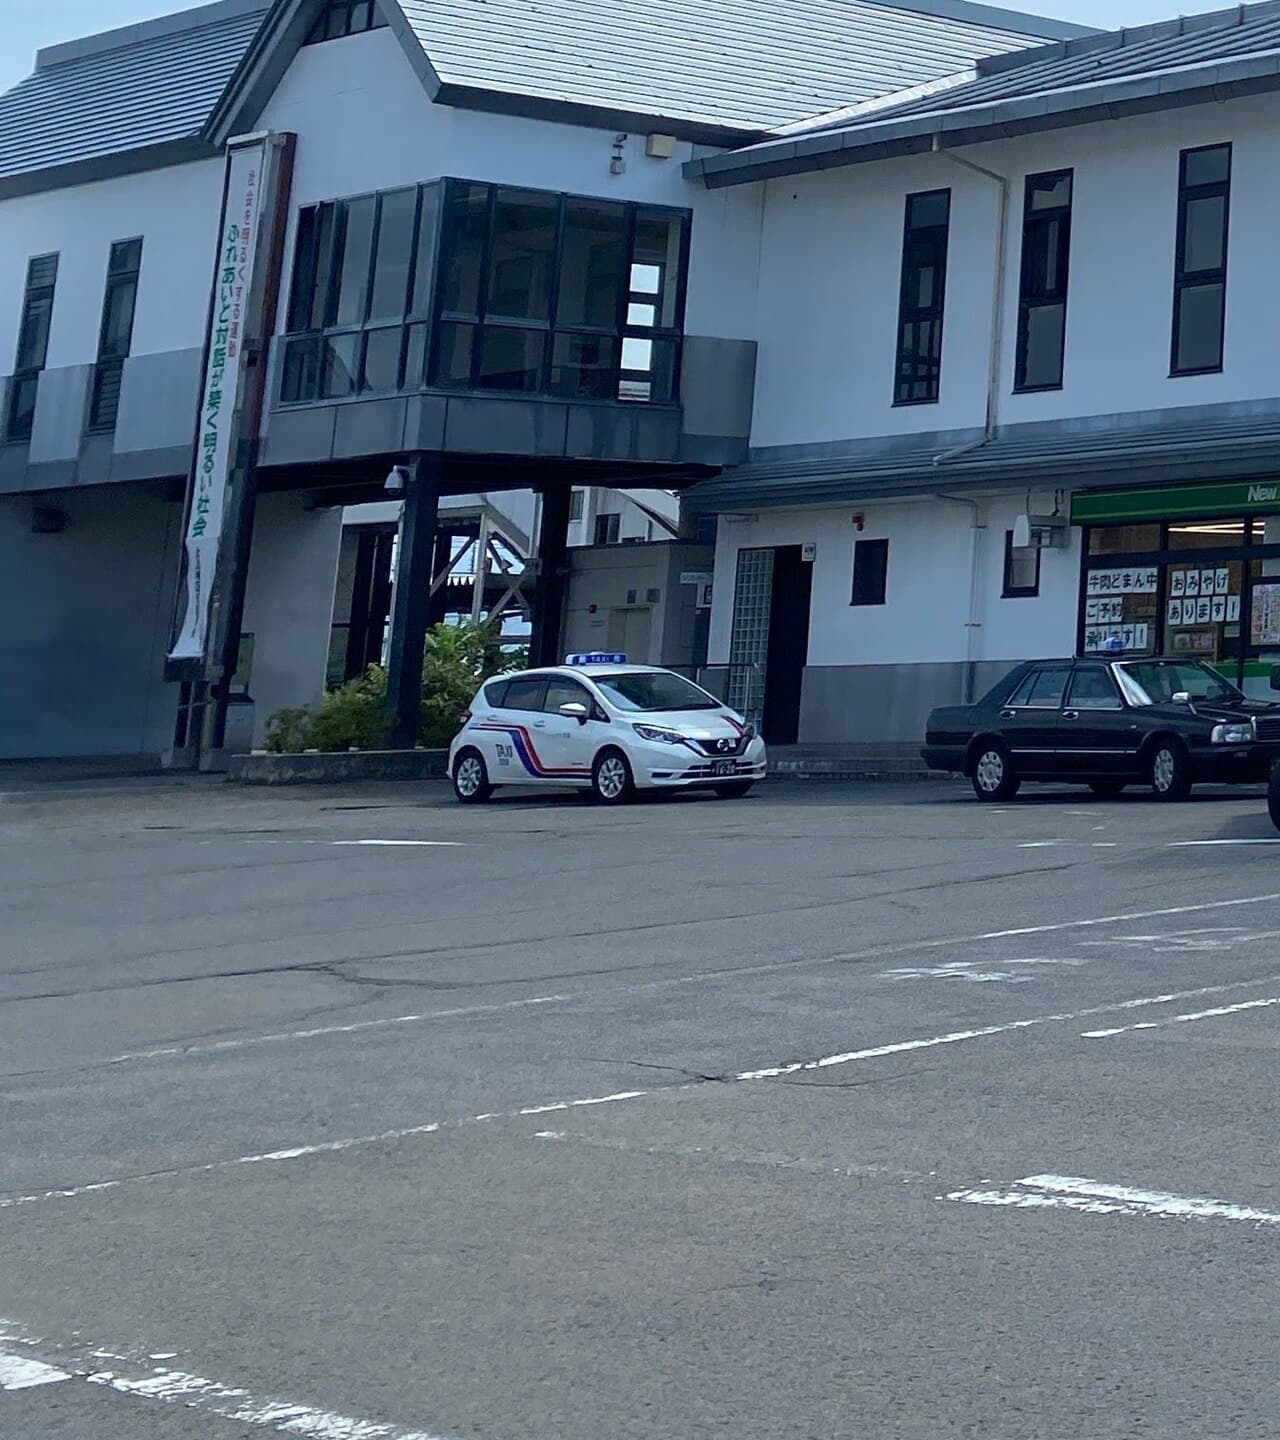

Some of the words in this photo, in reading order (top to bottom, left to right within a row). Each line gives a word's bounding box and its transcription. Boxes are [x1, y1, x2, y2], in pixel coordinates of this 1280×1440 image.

[192, 224, 240, 538] ふれあいと対話が築く明るい社会
[1088, 572, 1158, 590] 牛肉どまん中
[1172, 573, 1228, 592] おみやげ
[1086, 602, 1122, 619] ご予約
[1168, 603, 1236, 620] あります！
